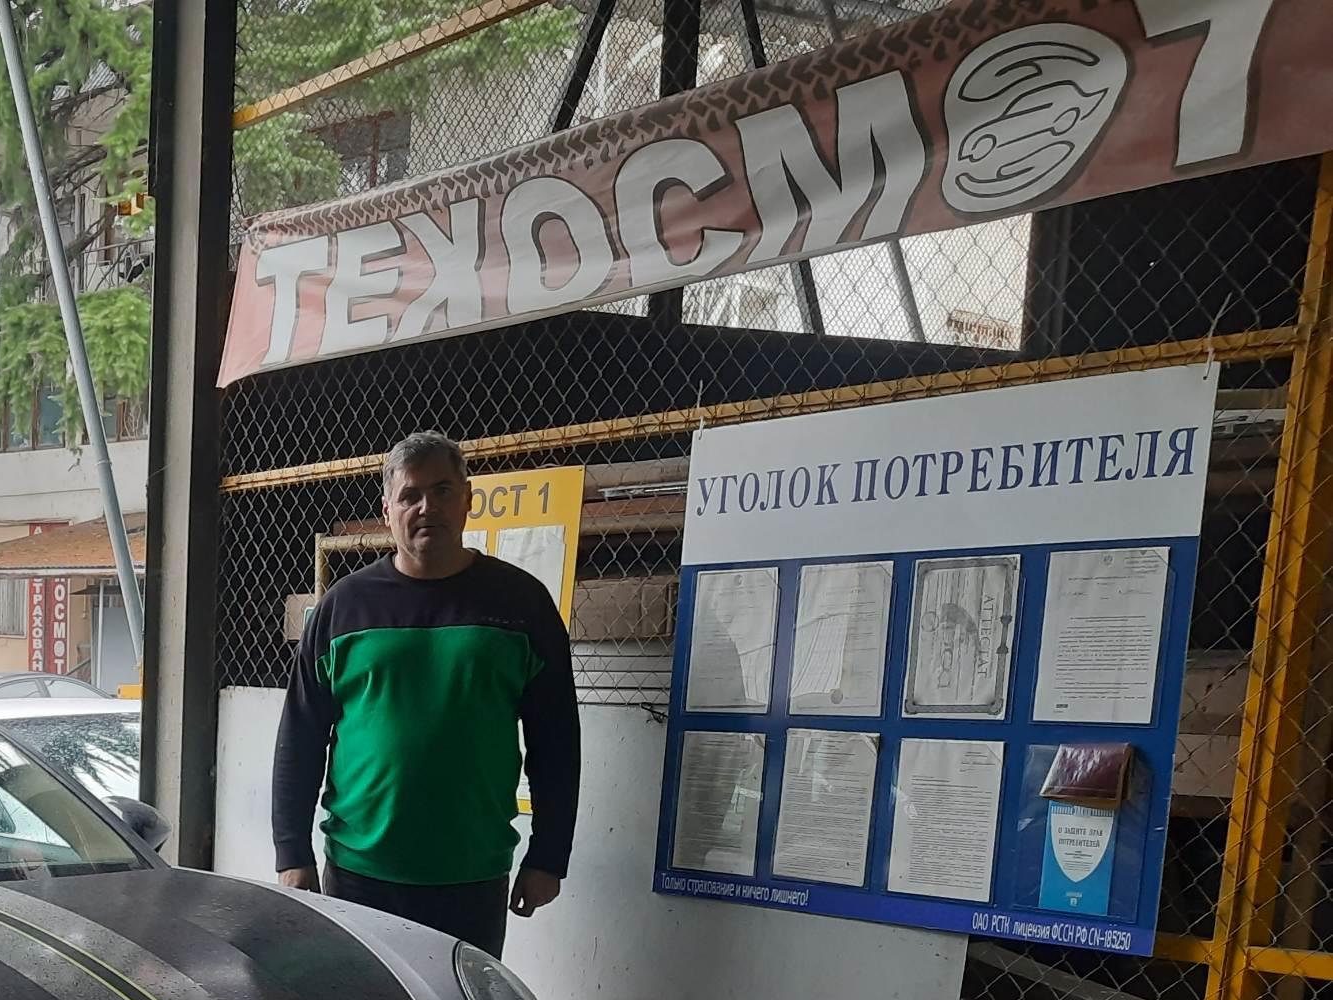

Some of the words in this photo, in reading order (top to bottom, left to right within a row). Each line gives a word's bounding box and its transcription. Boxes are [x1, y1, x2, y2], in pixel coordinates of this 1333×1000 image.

[467, 484, 528, 520] ОСТ
[537, 481, 550, 514] 1
[696, 462, 842, 517] УГОЛОК
[850, 426, 1200, 504] ПОТРЕБИТЕЛЯ
[31, 577, 44, 672] ТРАХОВАН
[53, 577, 66, 675] ОСМОТ
[661, 873, 686, 891] Только
[687, 878, 734, 896] страхование
[742, 886, 769, 901] ничего
[770, 888, 810, 907] лишнего!
[972, 912, 989, 931] ОАО
[991, 914, 1011, 934] РСТК
[1012, 920, 1051, 940] лицензия
[1051, 922, 1074, 943] ФССН
[1075, 926, 1088, 945] РФ
